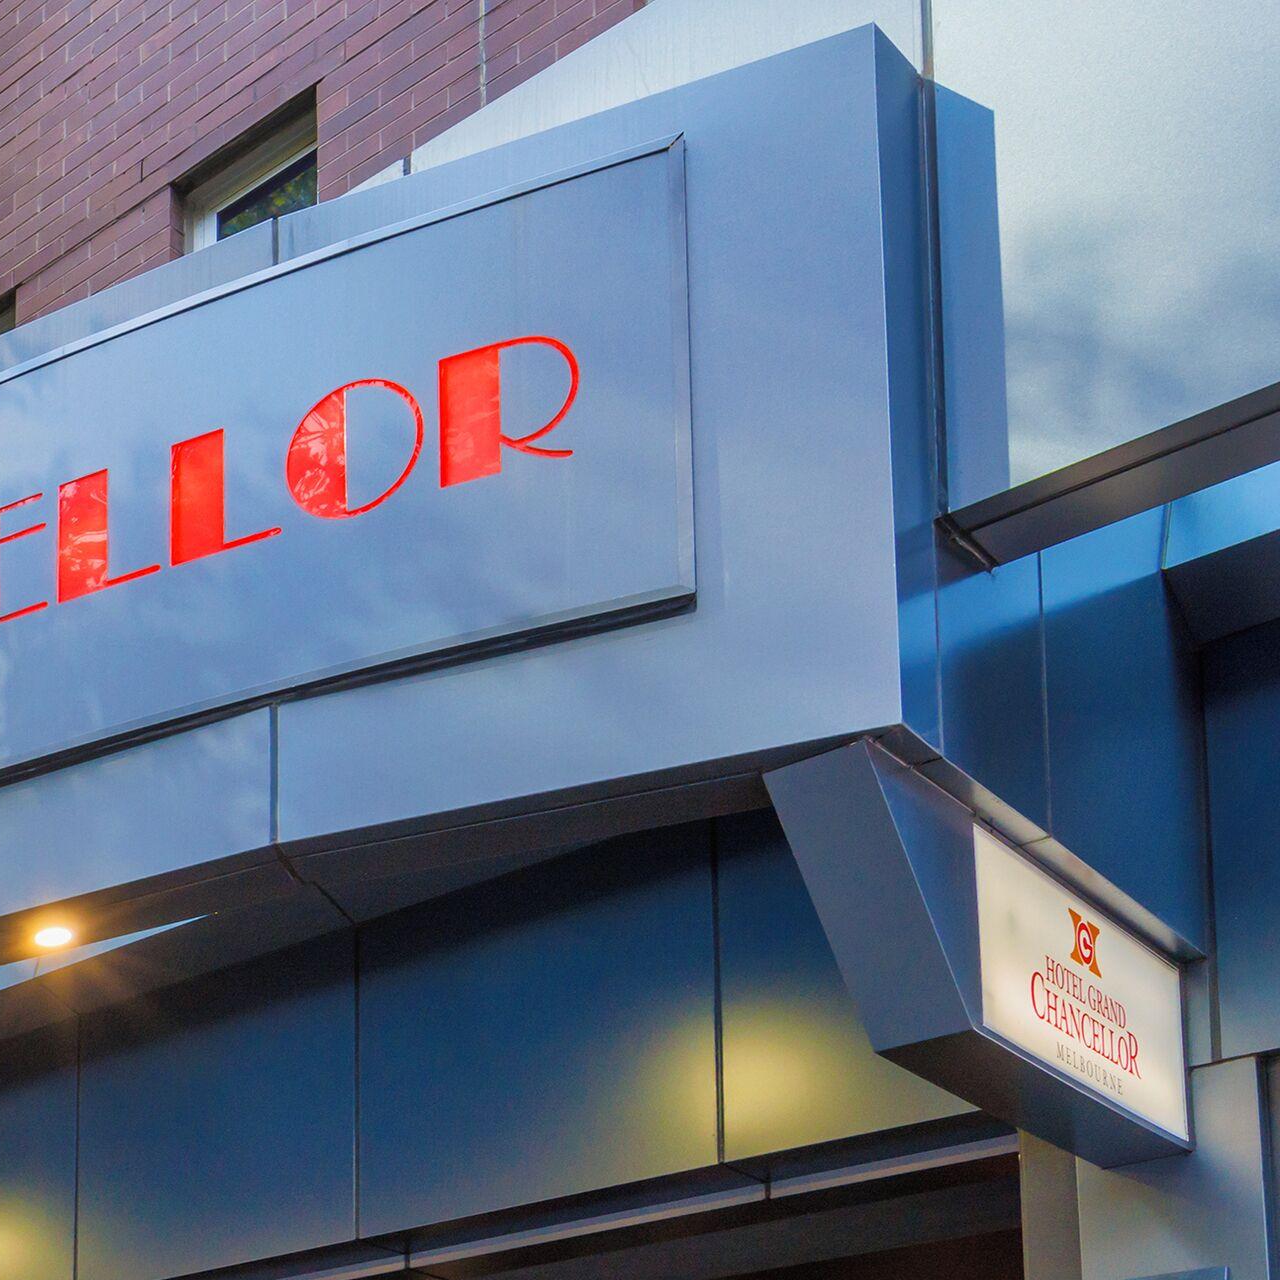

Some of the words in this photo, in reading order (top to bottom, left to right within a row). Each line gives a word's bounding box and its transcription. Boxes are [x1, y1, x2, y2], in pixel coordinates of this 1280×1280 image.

[1030, 971, 1142, 1080] CHANCELLOR
[1044, 955, 1086, 1005] HOTEL
[1087, 984, 1127, 1029] GRAND
[1056, 1041, 1123, 1096] MELBOURNE
